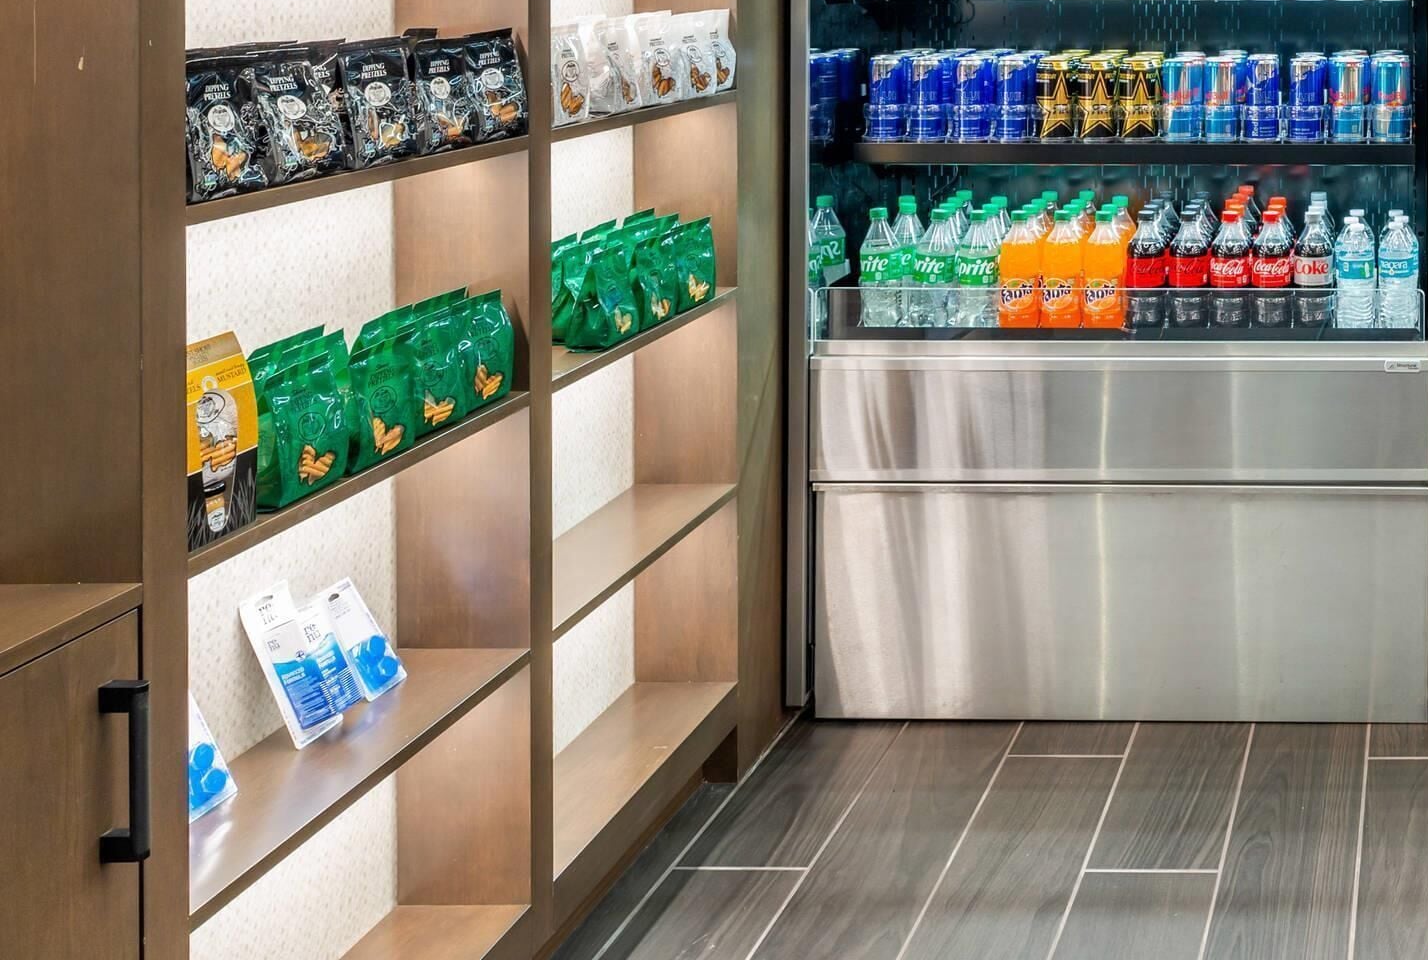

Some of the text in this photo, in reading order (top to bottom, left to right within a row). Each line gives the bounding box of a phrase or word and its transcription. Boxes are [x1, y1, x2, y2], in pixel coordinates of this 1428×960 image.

[861, 255, 889, 273] rite
[914, 255, 944, 275] rite
[957, 254, 994, 277] prite
[1294, 258, 1329, 275] Coke
